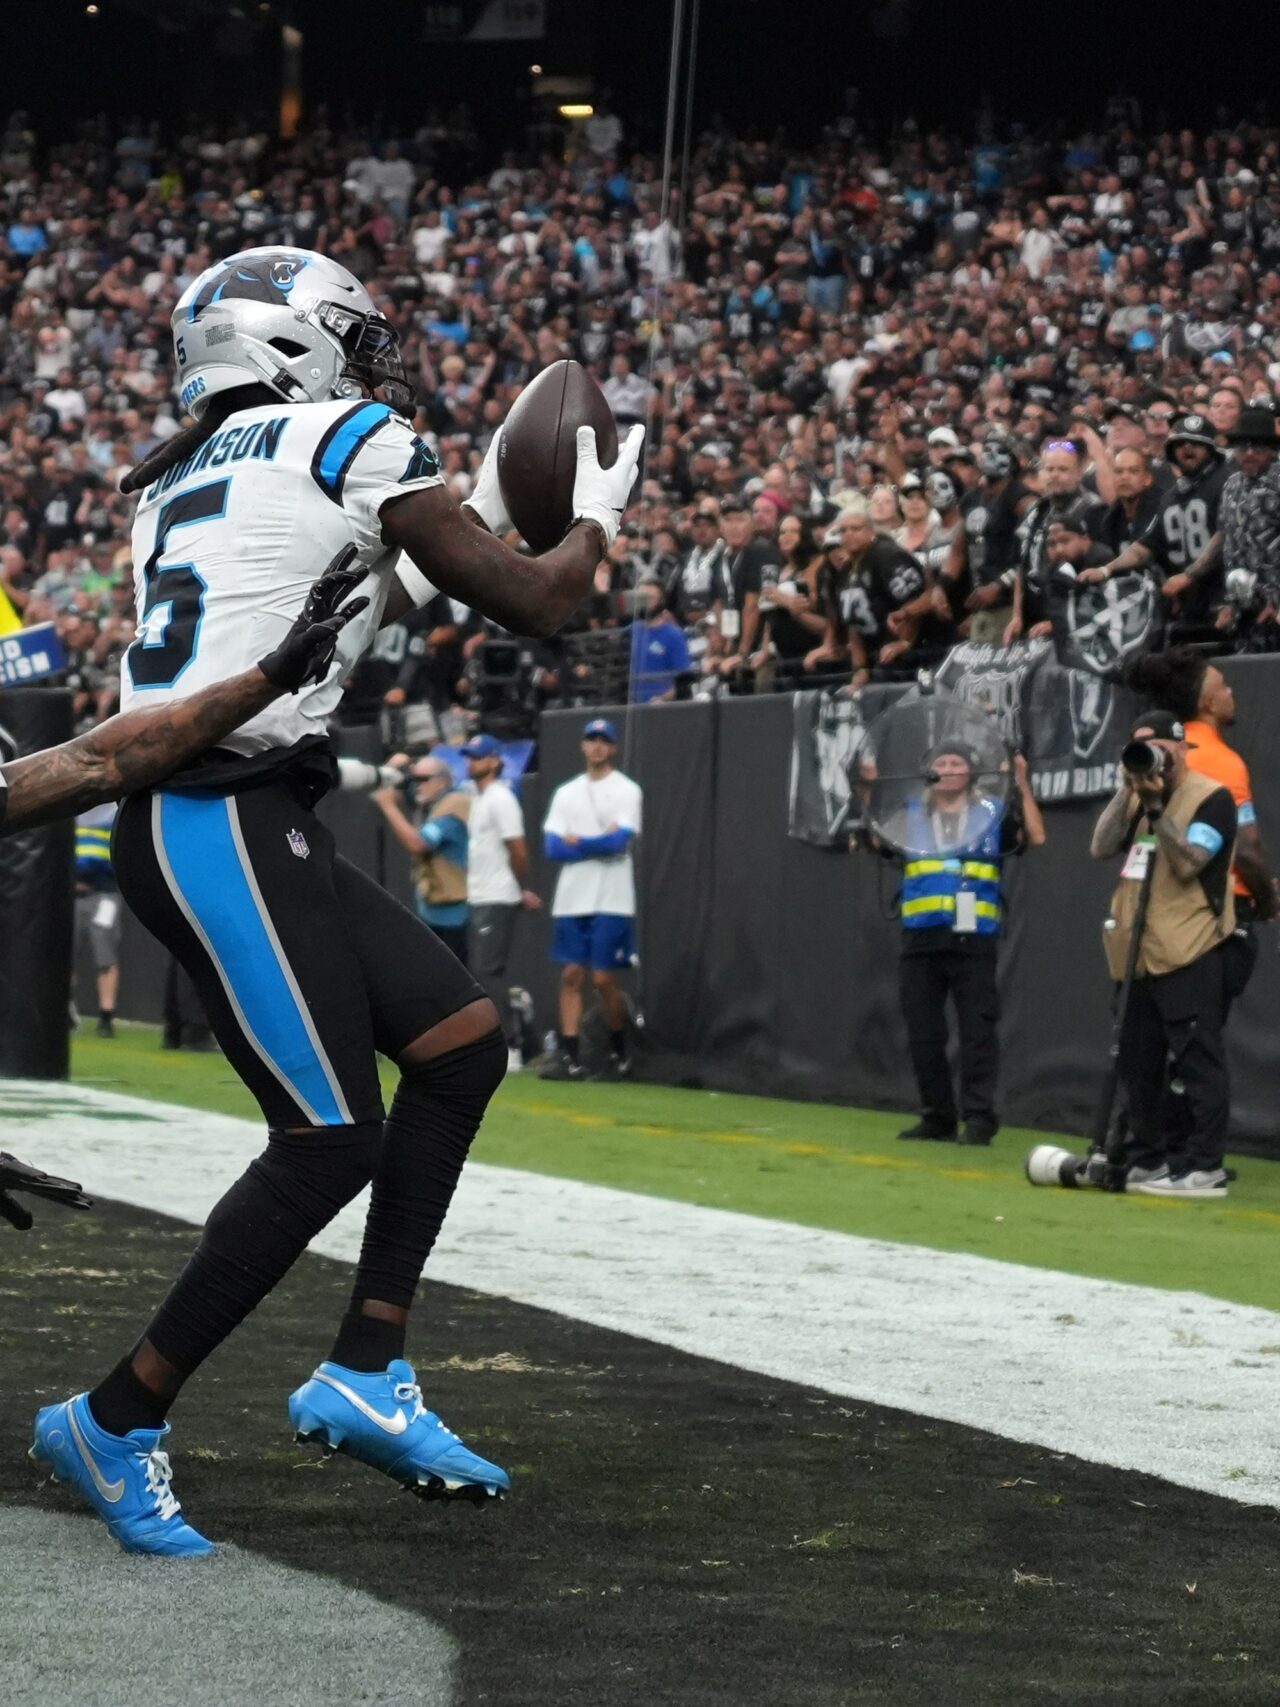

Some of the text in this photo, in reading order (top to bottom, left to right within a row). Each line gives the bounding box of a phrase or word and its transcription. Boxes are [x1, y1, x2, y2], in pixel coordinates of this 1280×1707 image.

[175, 337, 187, 366] 5
[1163, 498, 1212, 565] 98
[127, 475, 234, 691] 5
